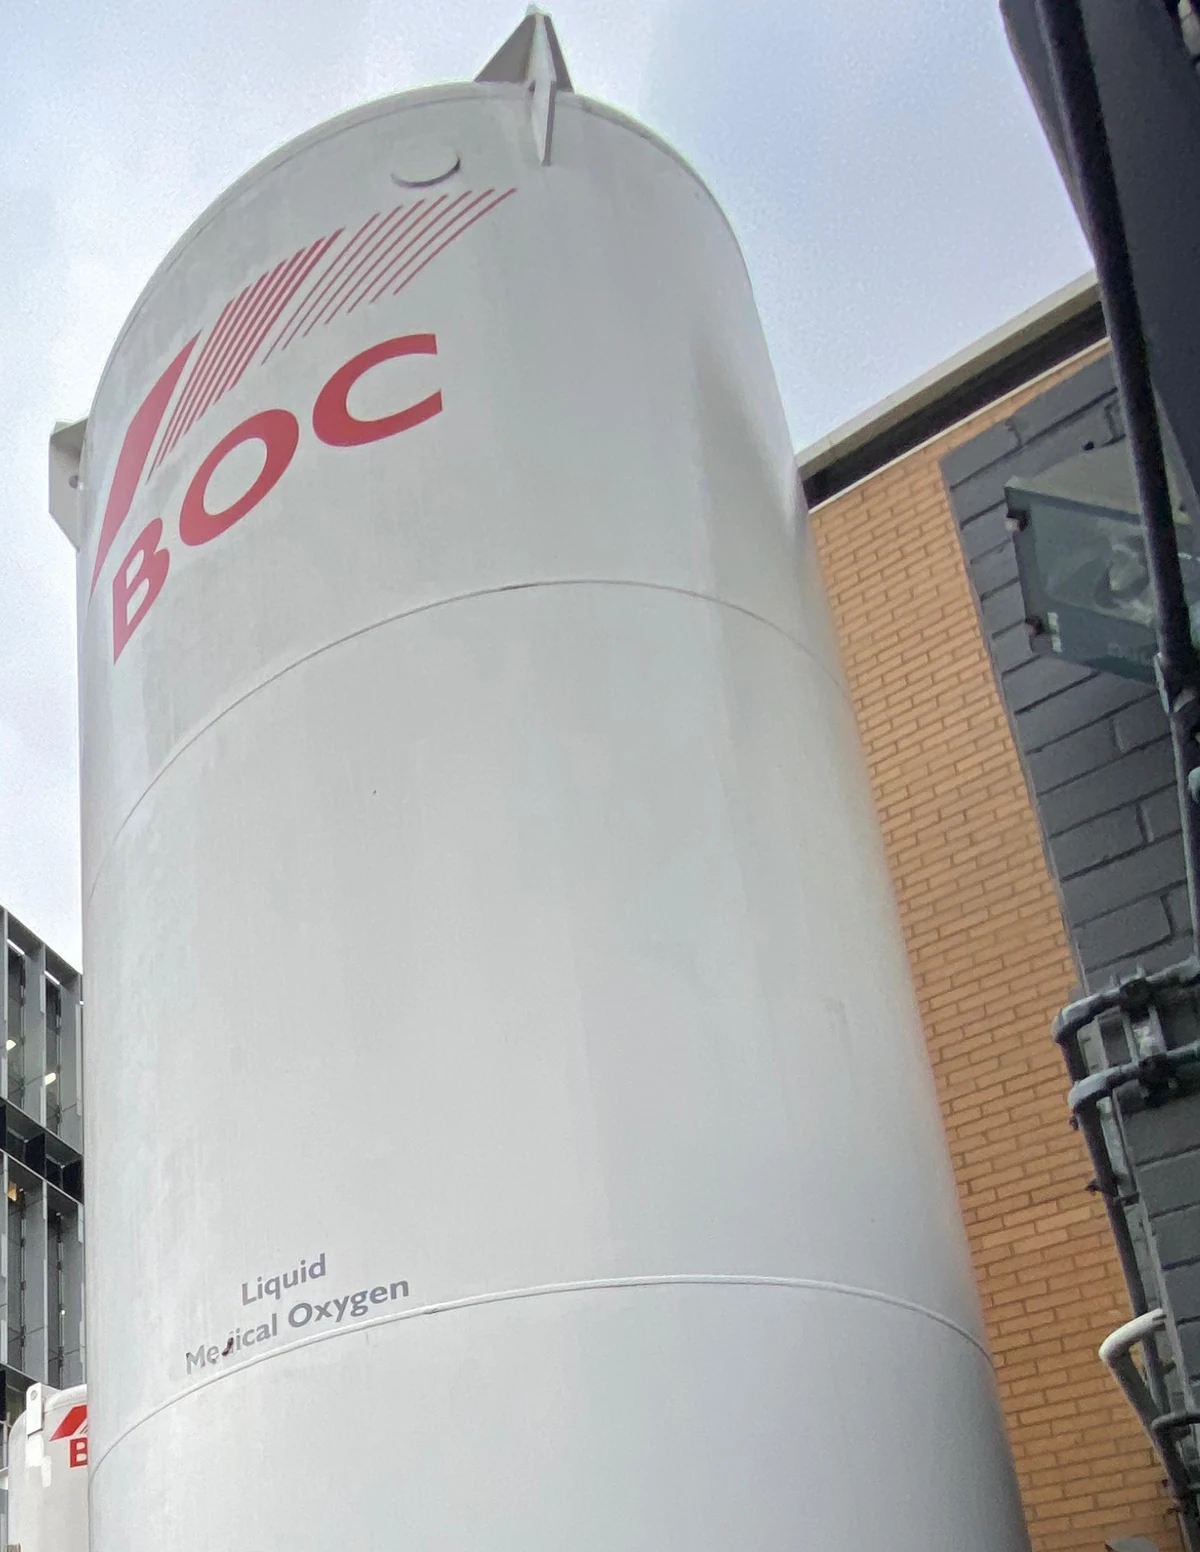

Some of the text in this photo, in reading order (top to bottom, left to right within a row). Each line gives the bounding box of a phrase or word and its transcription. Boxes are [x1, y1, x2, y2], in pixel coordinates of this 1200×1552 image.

[112, 333, 443, 666] BOC
[241, 1253, 326, 1306] Liquid
[287, 1280, 410, 1328] Oxygen
